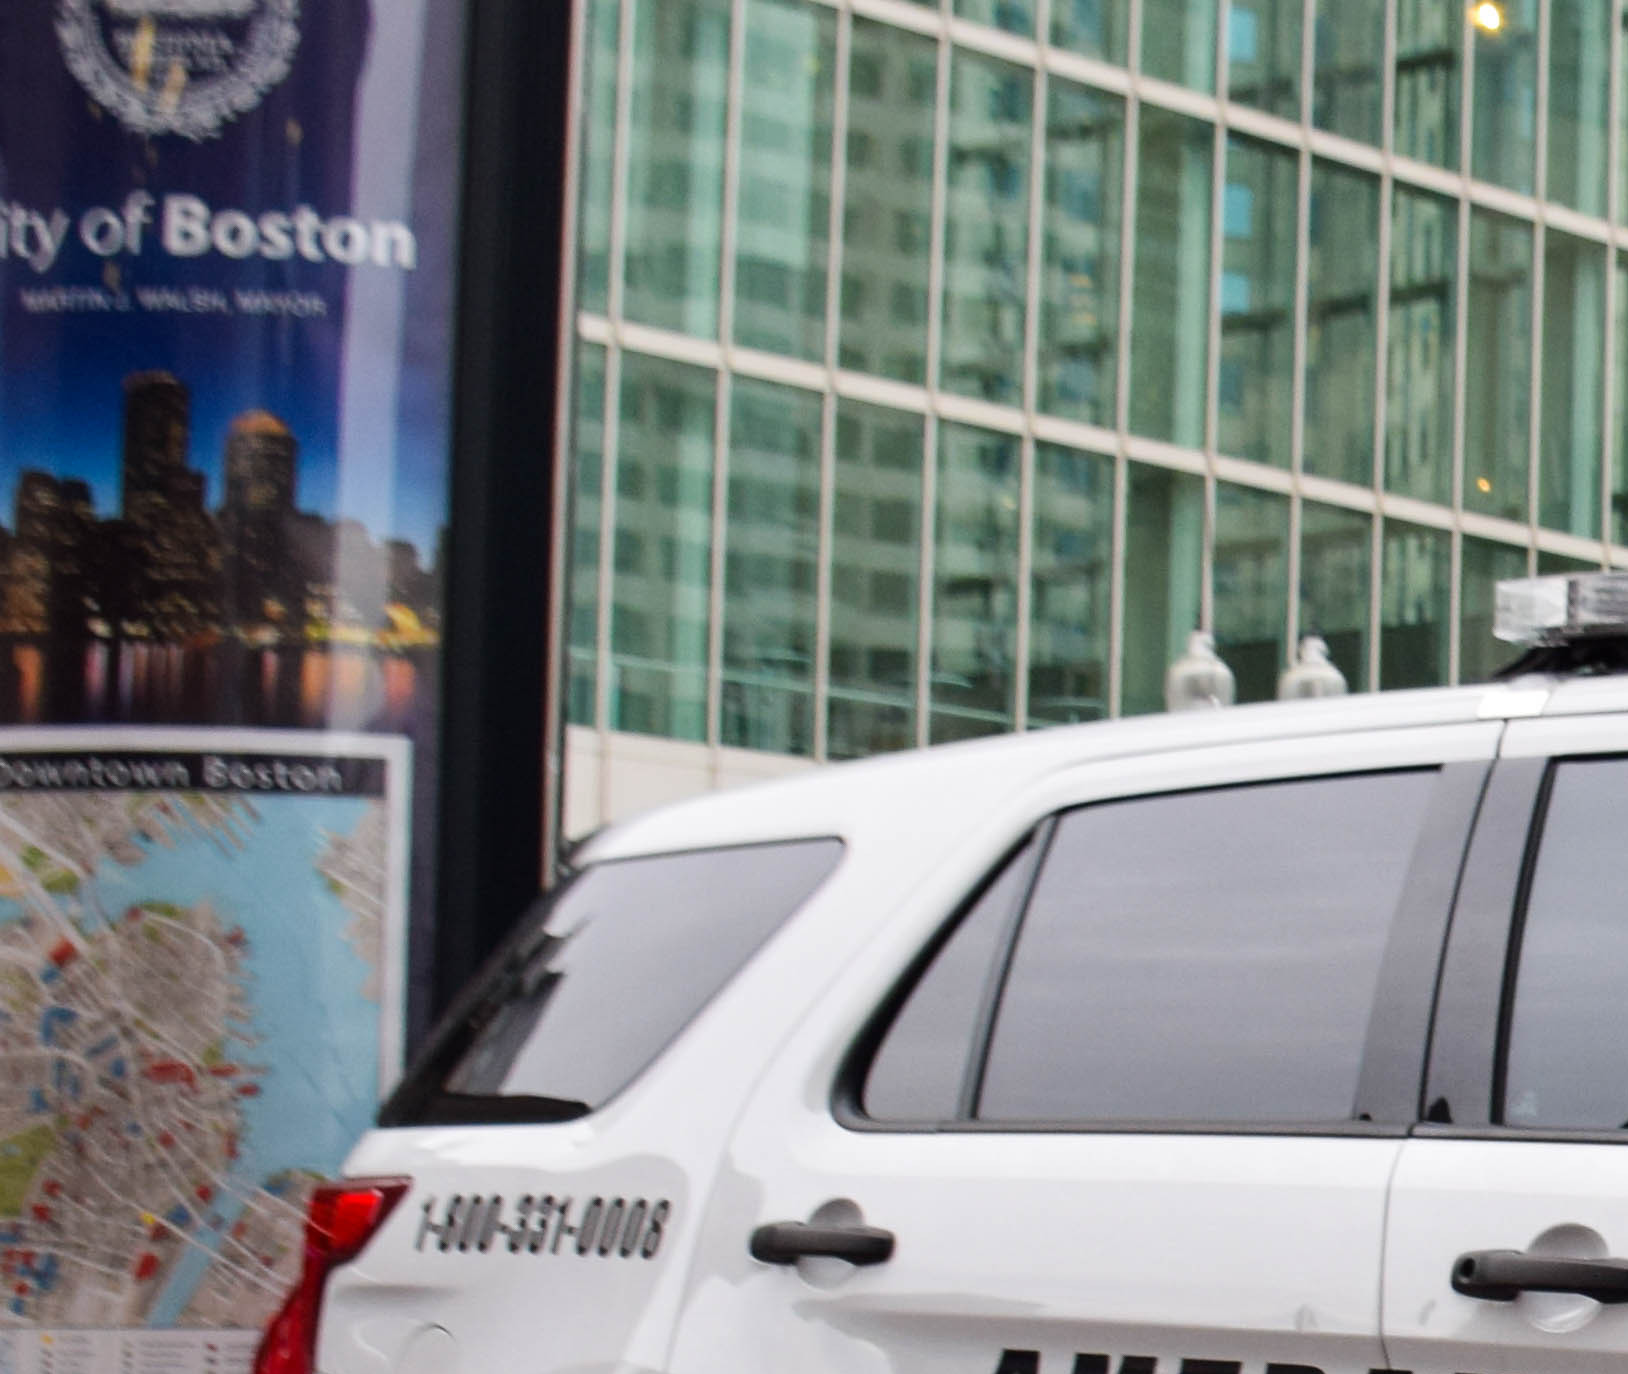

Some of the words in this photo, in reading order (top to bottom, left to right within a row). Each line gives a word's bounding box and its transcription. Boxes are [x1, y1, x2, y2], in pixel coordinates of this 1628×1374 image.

[0, 198, 71, 273] ity
[80, 188, 155, 256] of
[162, 193, 418, 271] Boston
[202, 755, 343, 792] Boston
